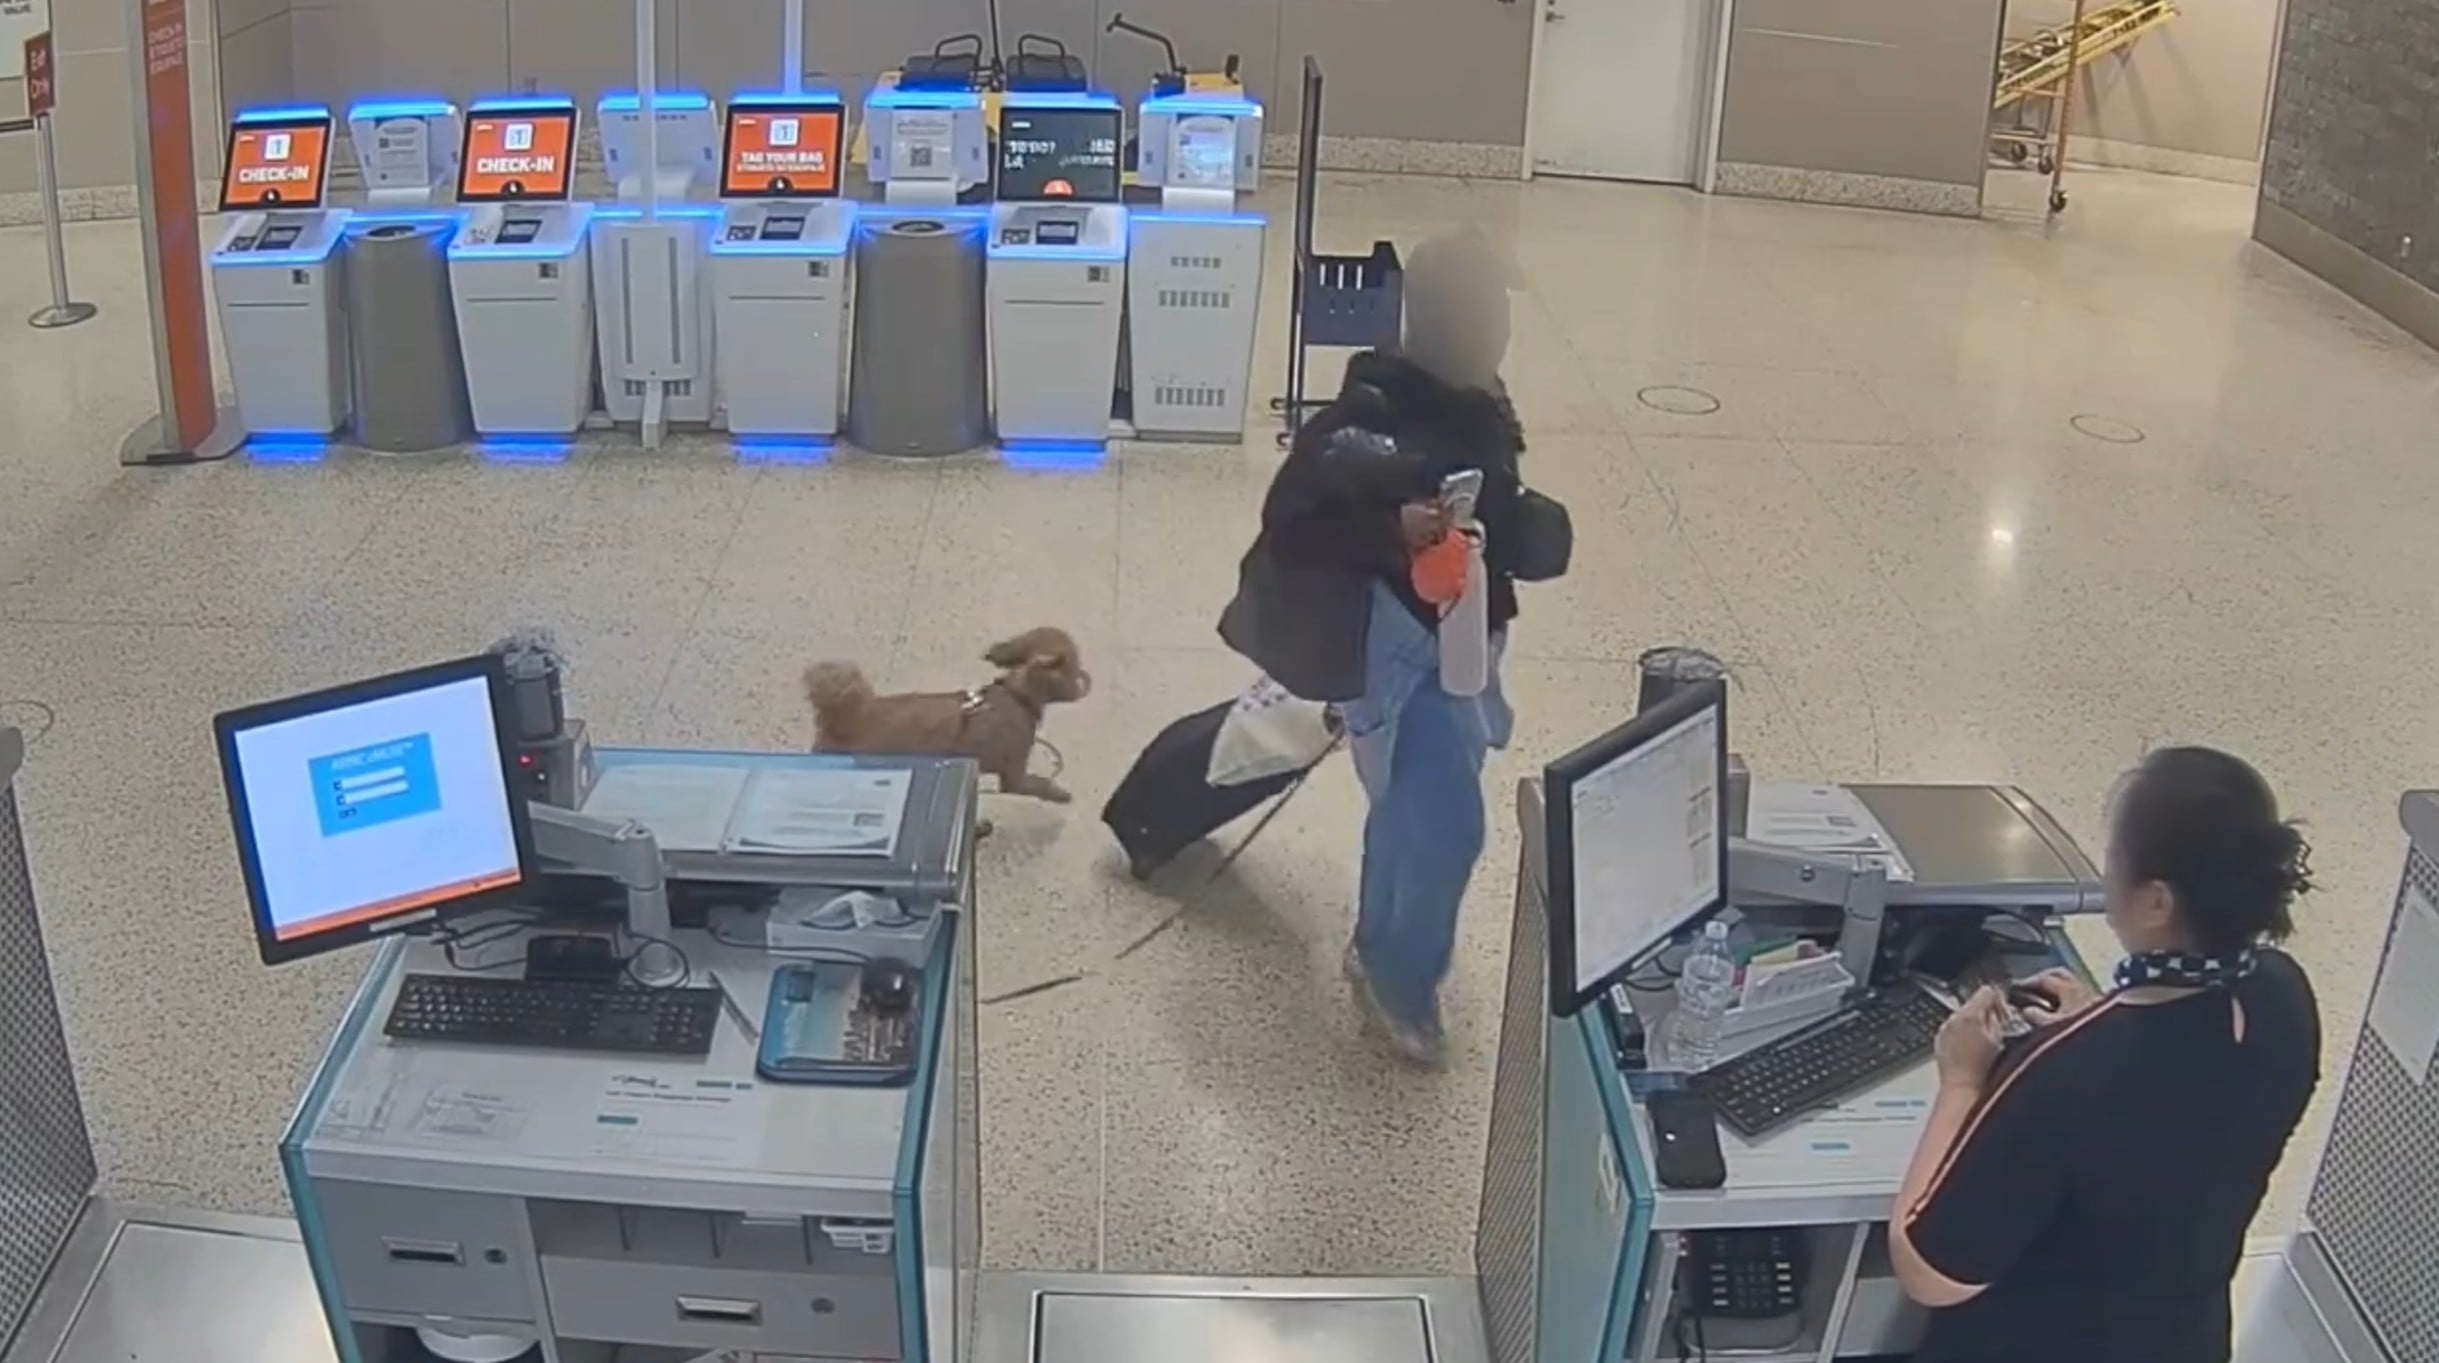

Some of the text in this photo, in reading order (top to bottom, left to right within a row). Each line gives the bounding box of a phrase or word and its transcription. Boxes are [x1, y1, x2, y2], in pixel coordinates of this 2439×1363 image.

[477, 156, 554, 173] CHECK-IN
[742, 151, 823, 162] TAG YOUR BAG
[240, 165, 309, 182] CHECK-IN
